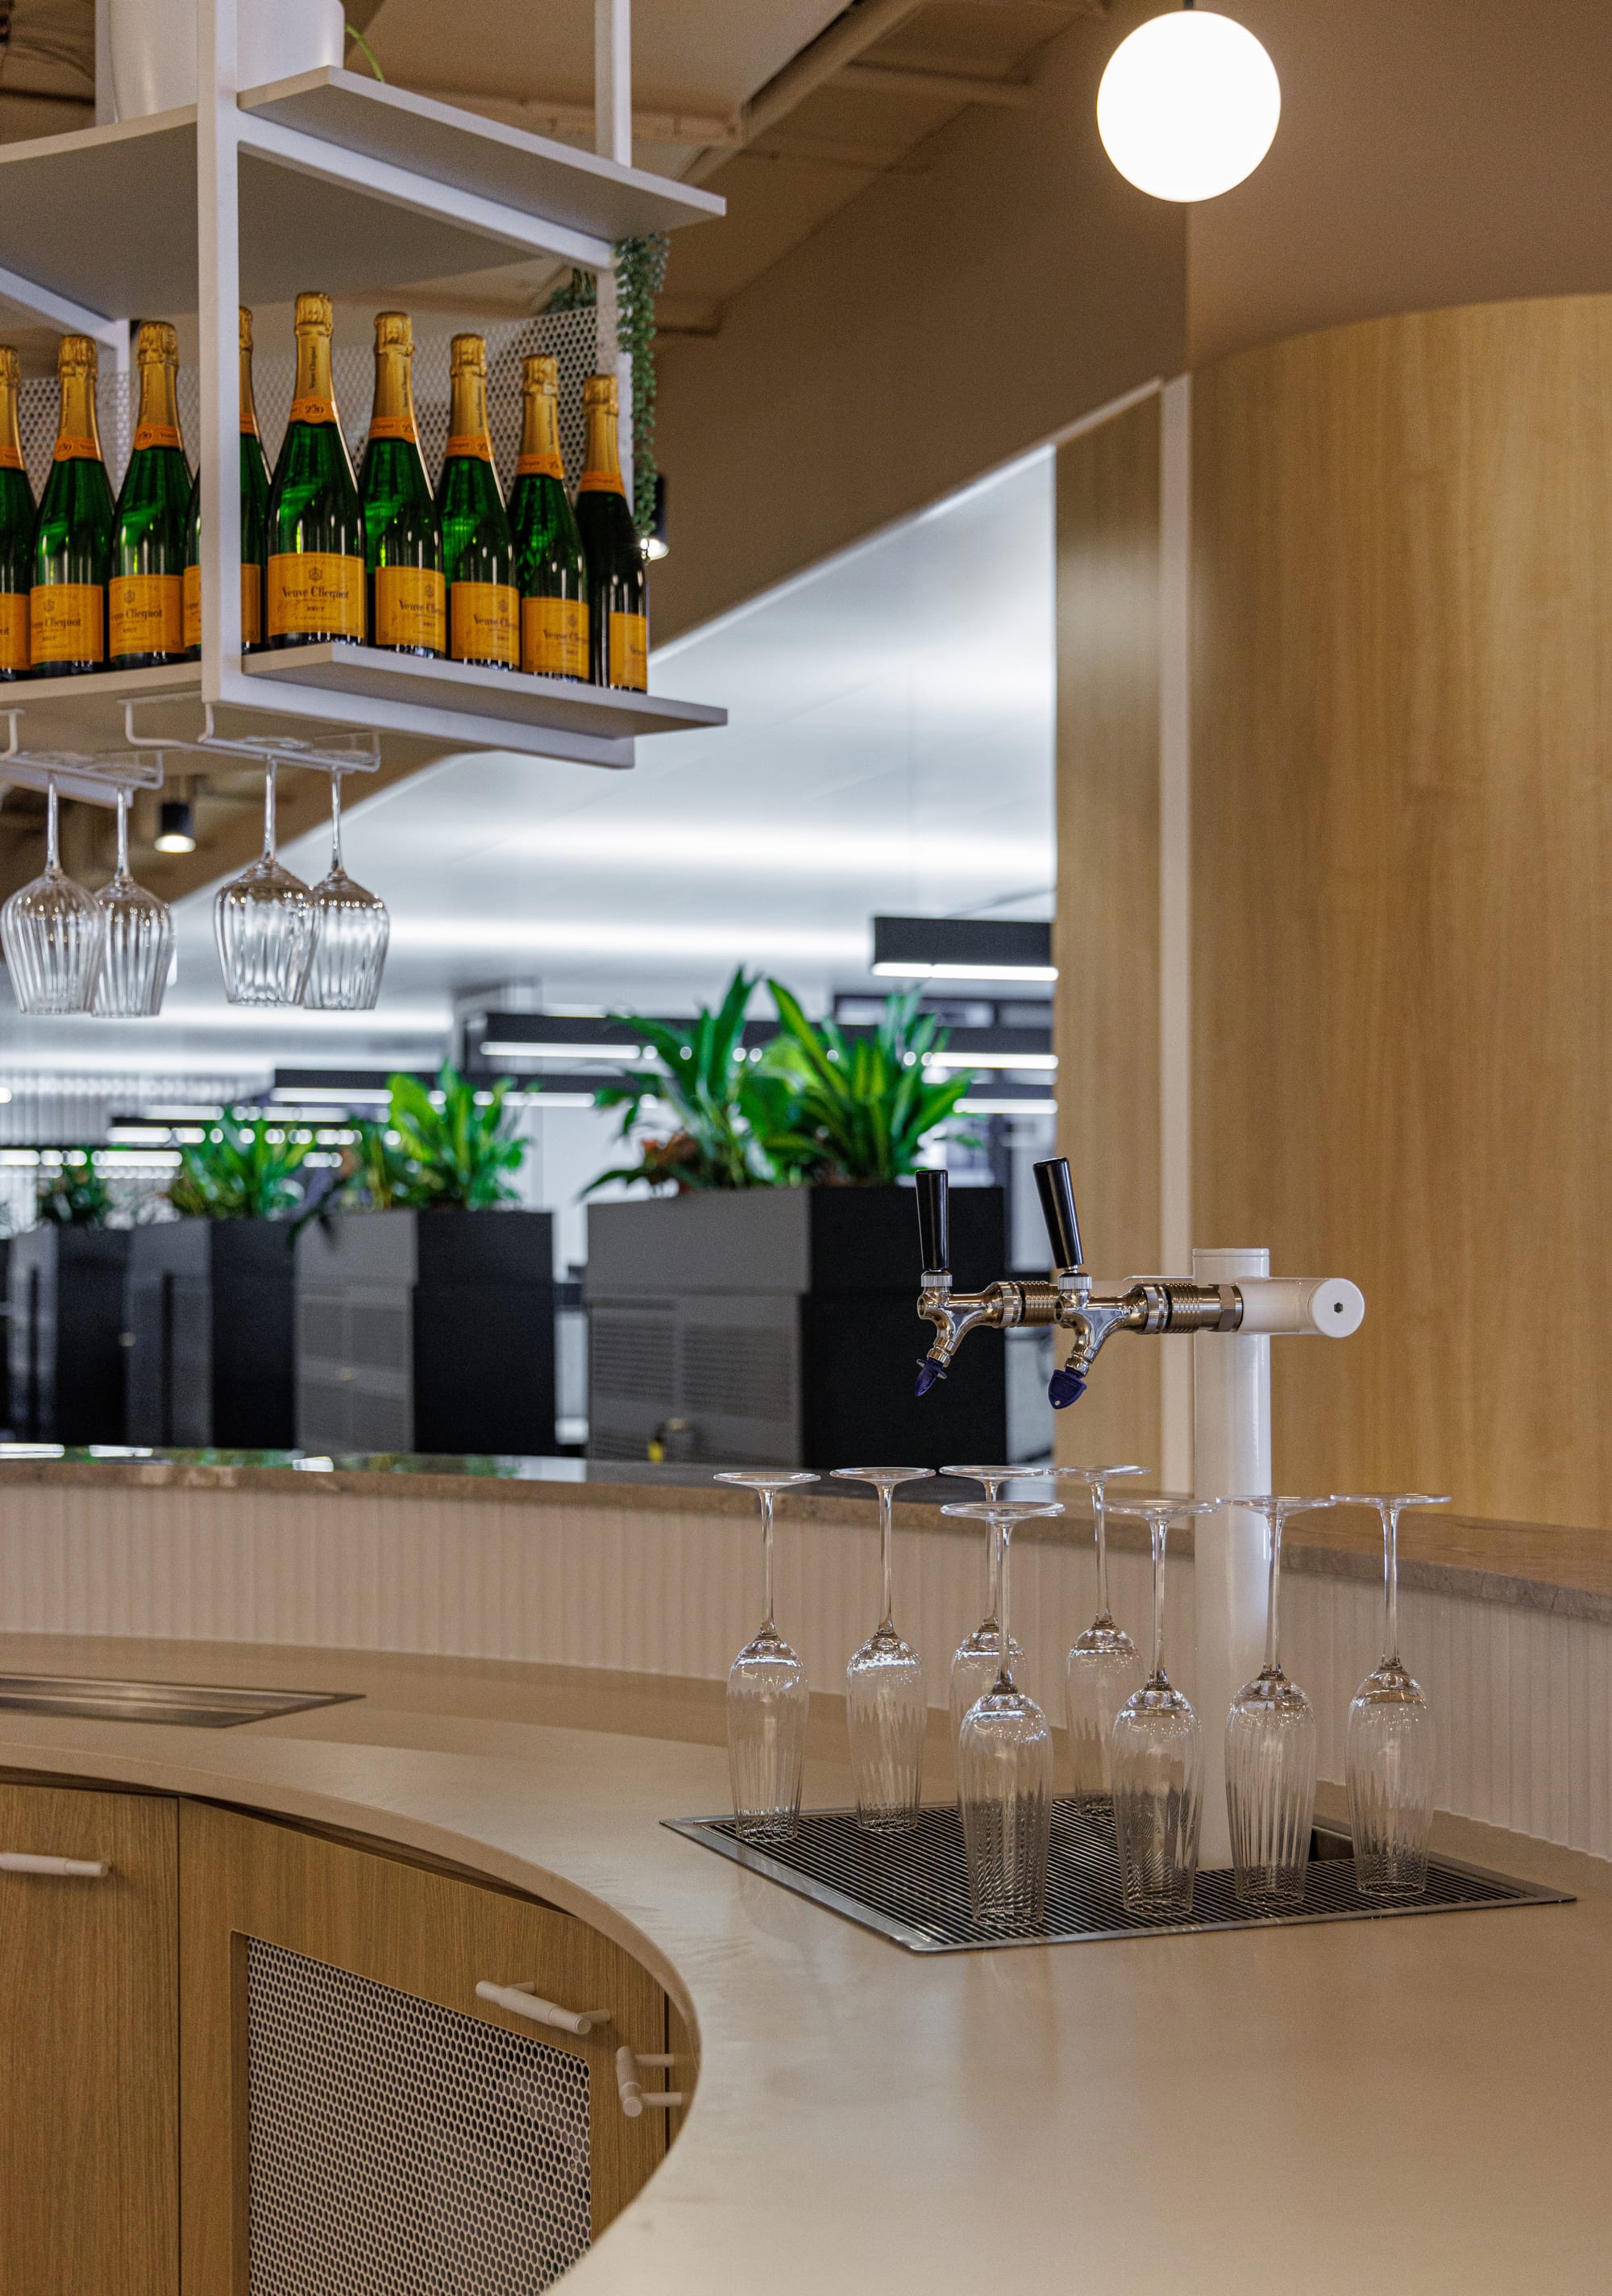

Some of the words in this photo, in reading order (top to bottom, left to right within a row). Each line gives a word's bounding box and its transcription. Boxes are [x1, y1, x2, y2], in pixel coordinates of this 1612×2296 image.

[282, 586, 308, 598] Veuve
[310, 585, 349, 601] Clicquot
[399, 598, 424, 611] Veuve
[126, 608, 163, 621] Clicquot
